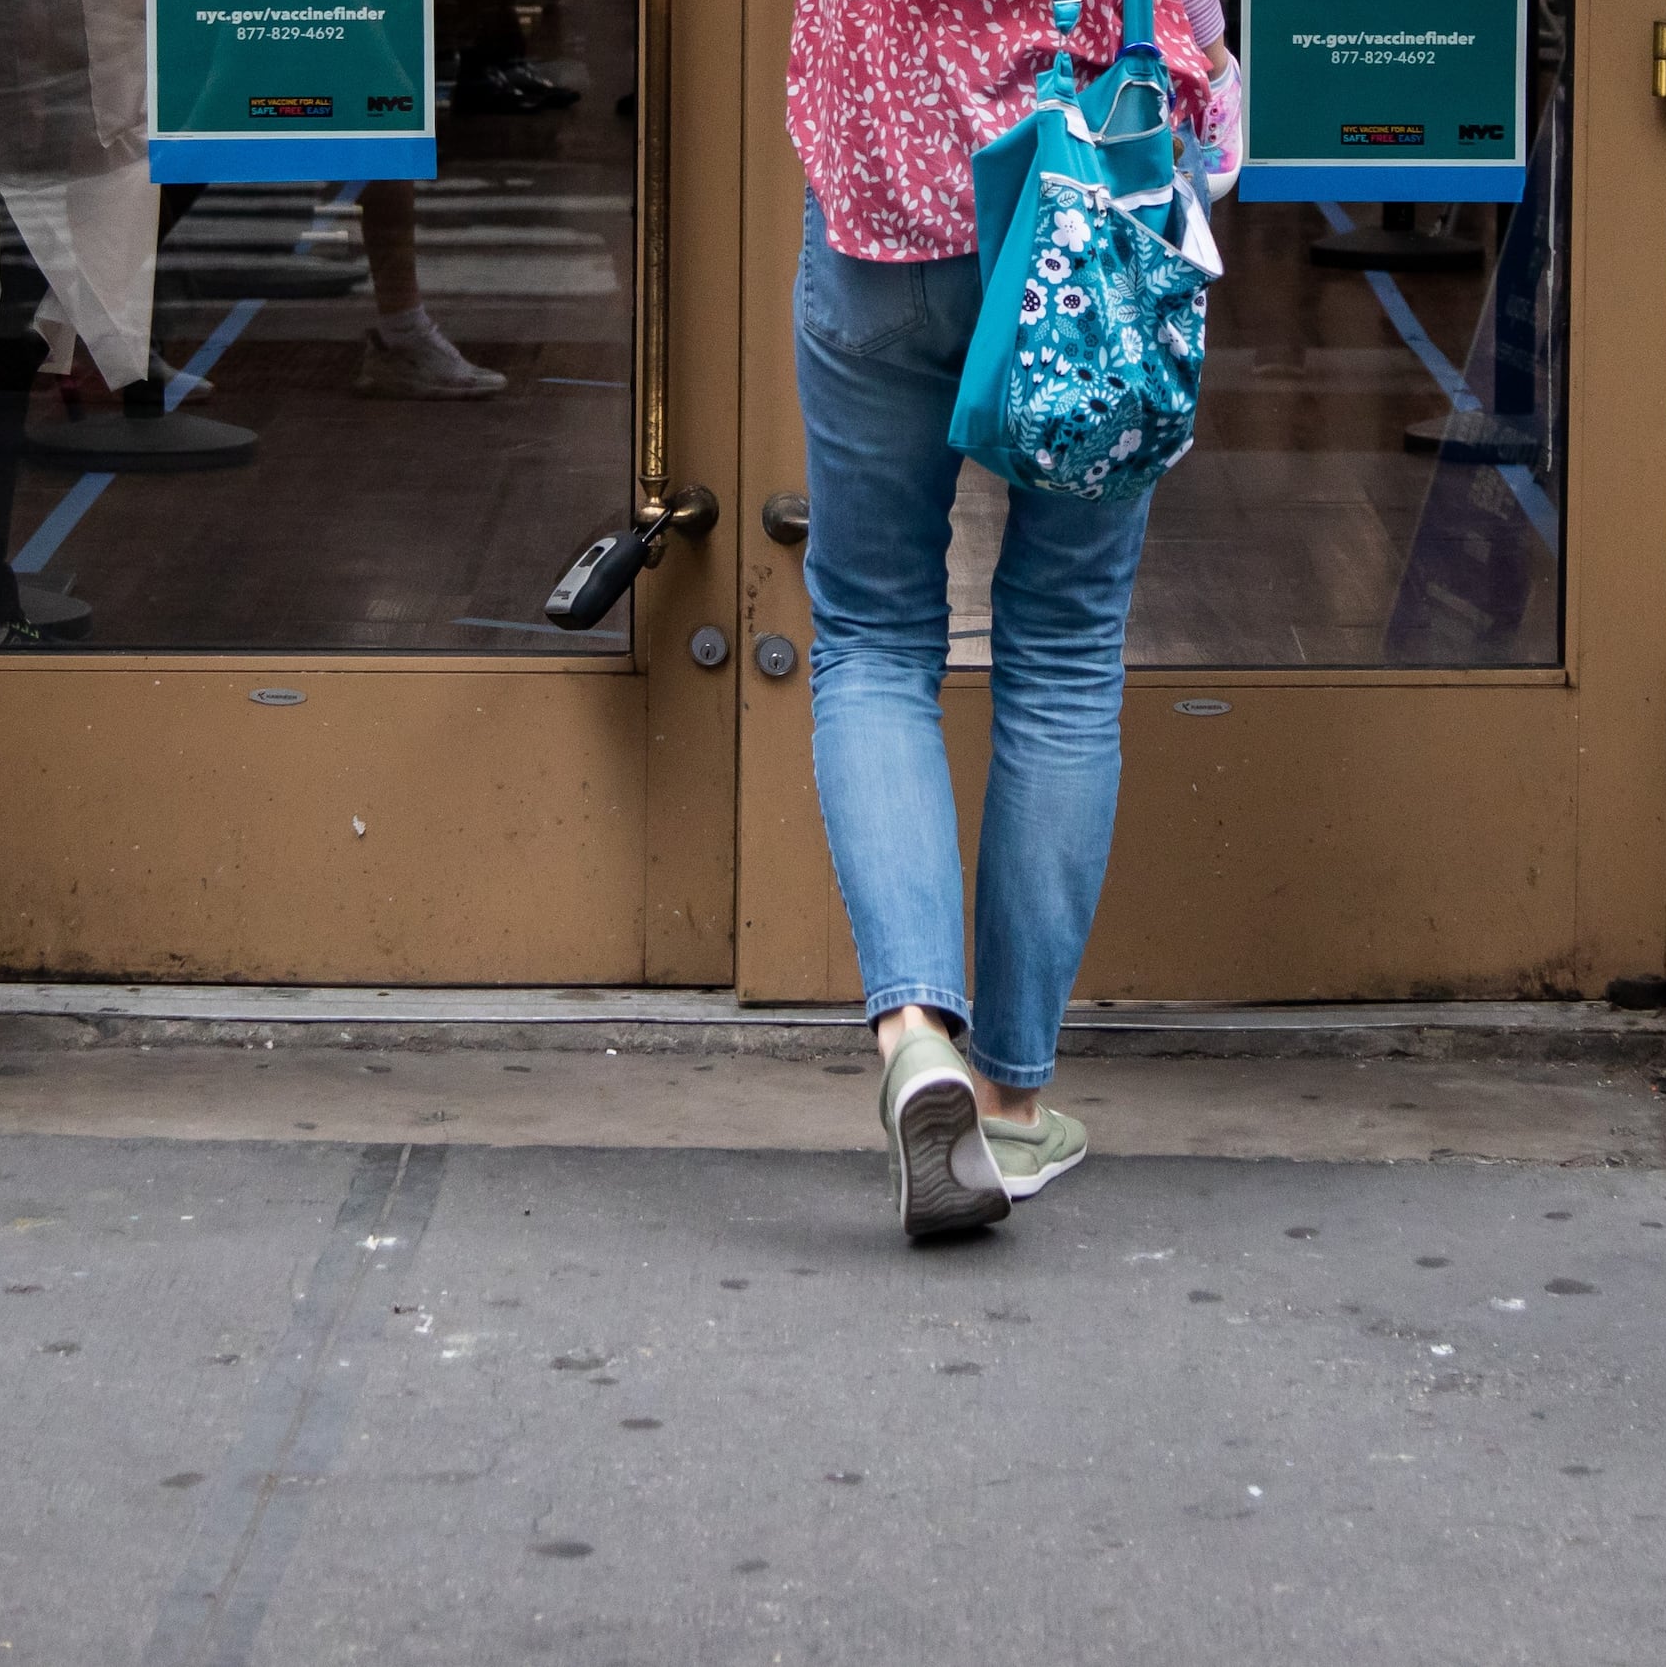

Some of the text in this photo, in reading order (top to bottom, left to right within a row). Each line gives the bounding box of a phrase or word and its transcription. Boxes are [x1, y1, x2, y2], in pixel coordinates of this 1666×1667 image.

[196, 6, 385, 24] nyc.gov/vaccinefinder
[236, 27, 345, 40] 877-829-4692
[1292, 31, 1475, 48] nyc.gov/vaccinefinder
[1331, 51, 1436, 65] 877-829-4692
[367, 96, 413, 112] NYC
[1458, 124, 1504, 140] NYC
